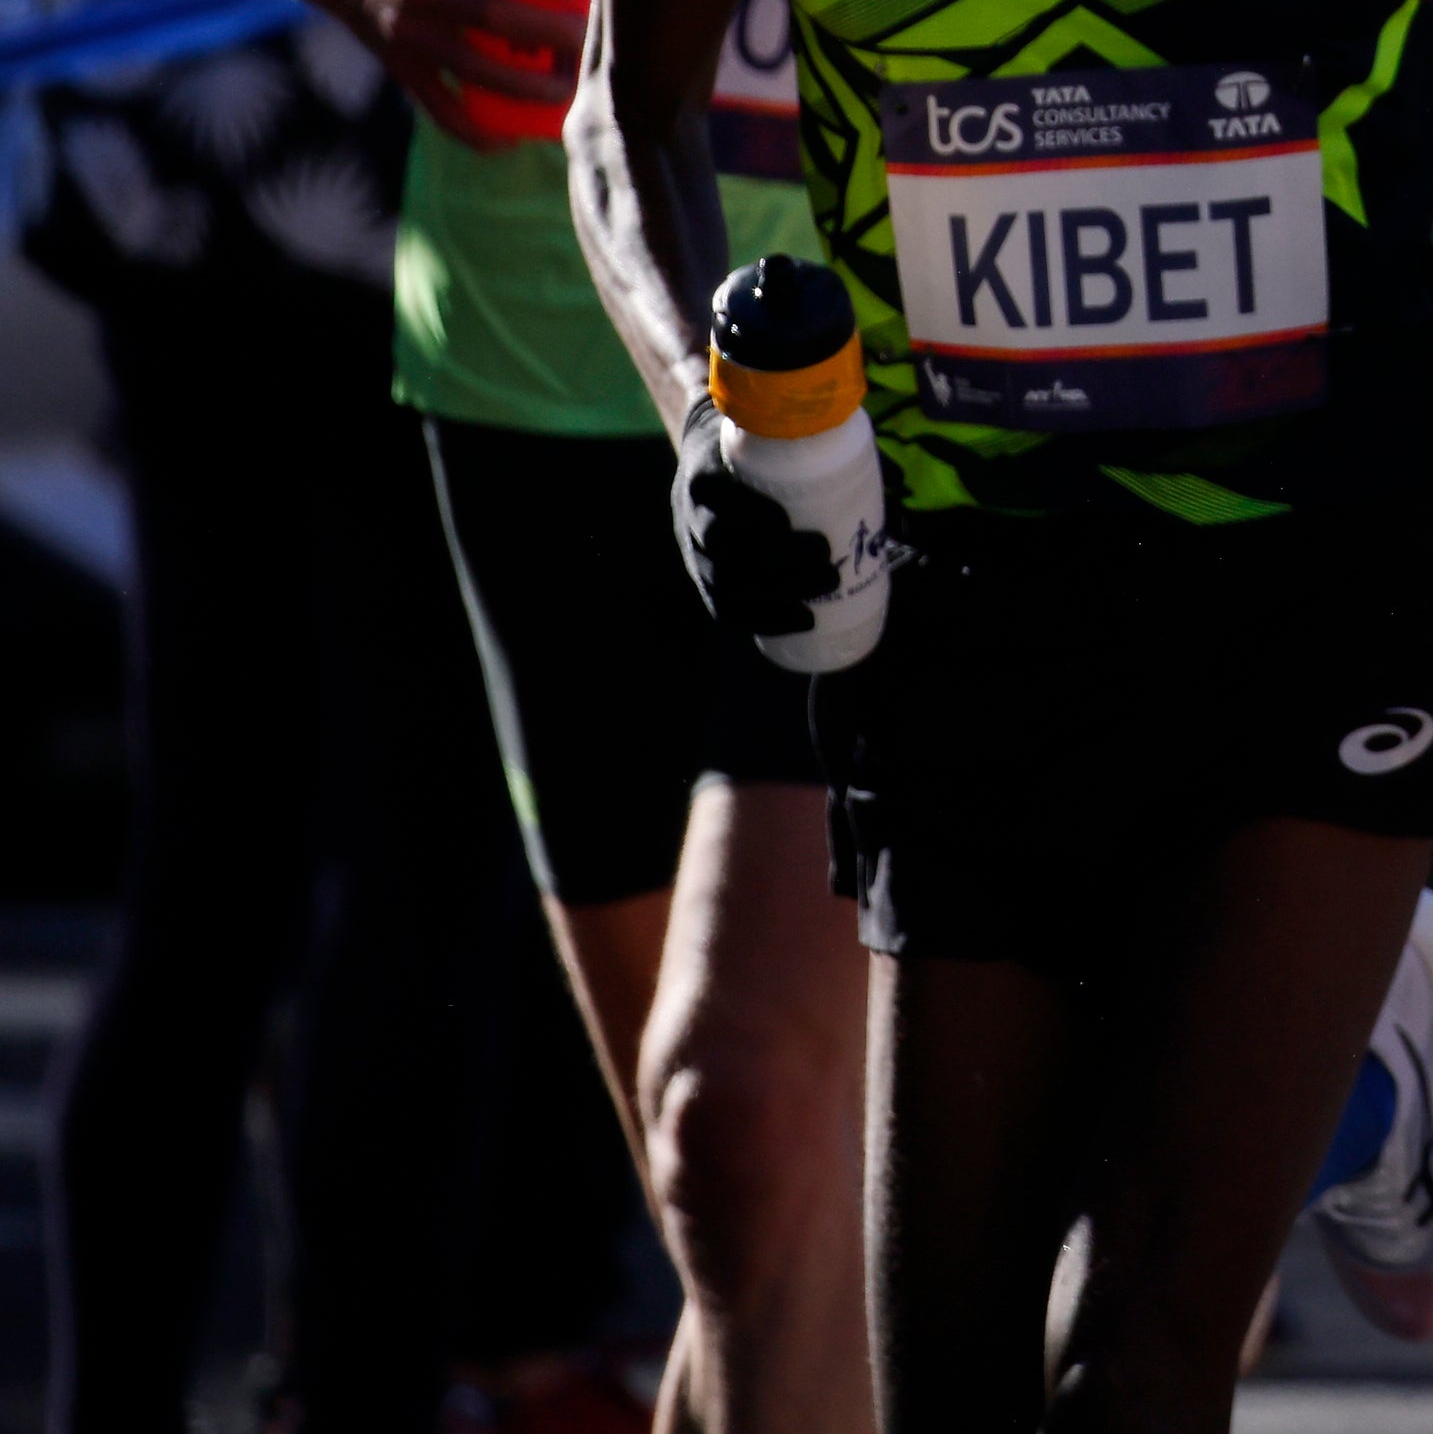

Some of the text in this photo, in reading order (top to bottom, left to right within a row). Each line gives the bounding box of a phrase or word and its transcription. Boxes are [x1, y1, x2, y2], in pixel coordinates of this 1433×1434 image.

[1031, 84, 1092, 104] TATA
[927, 94, 1023, 155] tcs
[1032, 103, 1172, 127] CONSULTANCY
[1207, 112, 1282, 140] TATA
[1033, 127, 1123, 149] SERVICES
[949, 196, 1271, 329] KIBET
